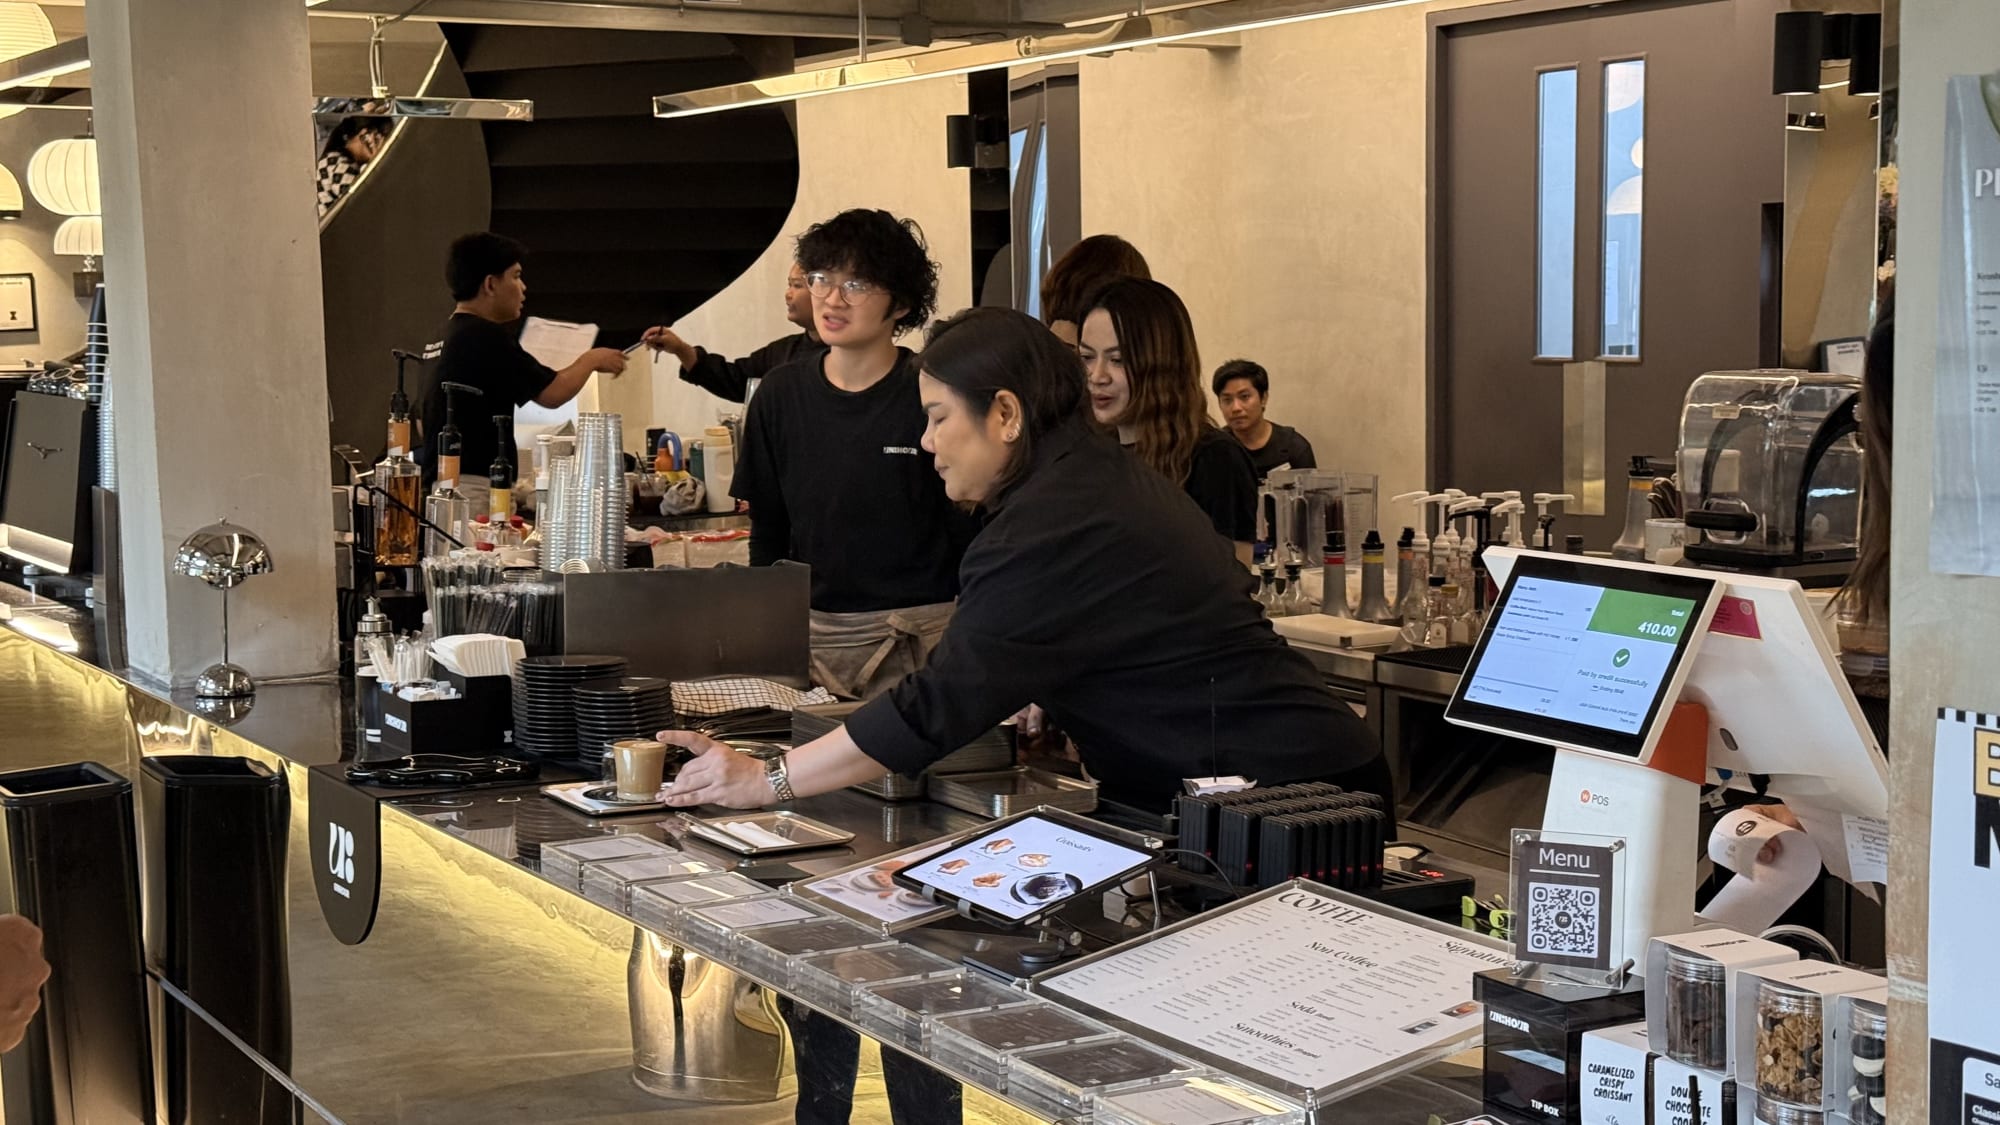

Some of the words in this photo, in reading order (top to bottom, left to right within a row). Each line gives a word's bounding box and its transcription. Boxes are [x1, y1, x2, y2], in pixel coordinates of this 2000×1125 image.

[1638, 621, 1676, 637] 410.00
[1590, 671, 1597, 679] by
[1614, 677, 1648, 688] successfully
[1592, 794, 1609, 806] POS
[1539, 848, 1590, 868] Menu
[1278, 892, 1373, 926] COFFEE
[1286, 1001, 1317, 1014] Soda
[1230, 1022, 1296, 1048] Smoothies
[1587, 1063, 1635, 1080] CARAMELIZED
[1599, 1076, 1625, 1090] CRISPY
[1593, 1087, 1633, 1103] CROISSANT
[1671, 1086, 1703, 1102] DOUE
[1530, 1099, 1543, 1110] TIP
[1543, 1103, 1560, 1117] BOX
[1665, 1099, 1711, 1118] CHOCOTE
